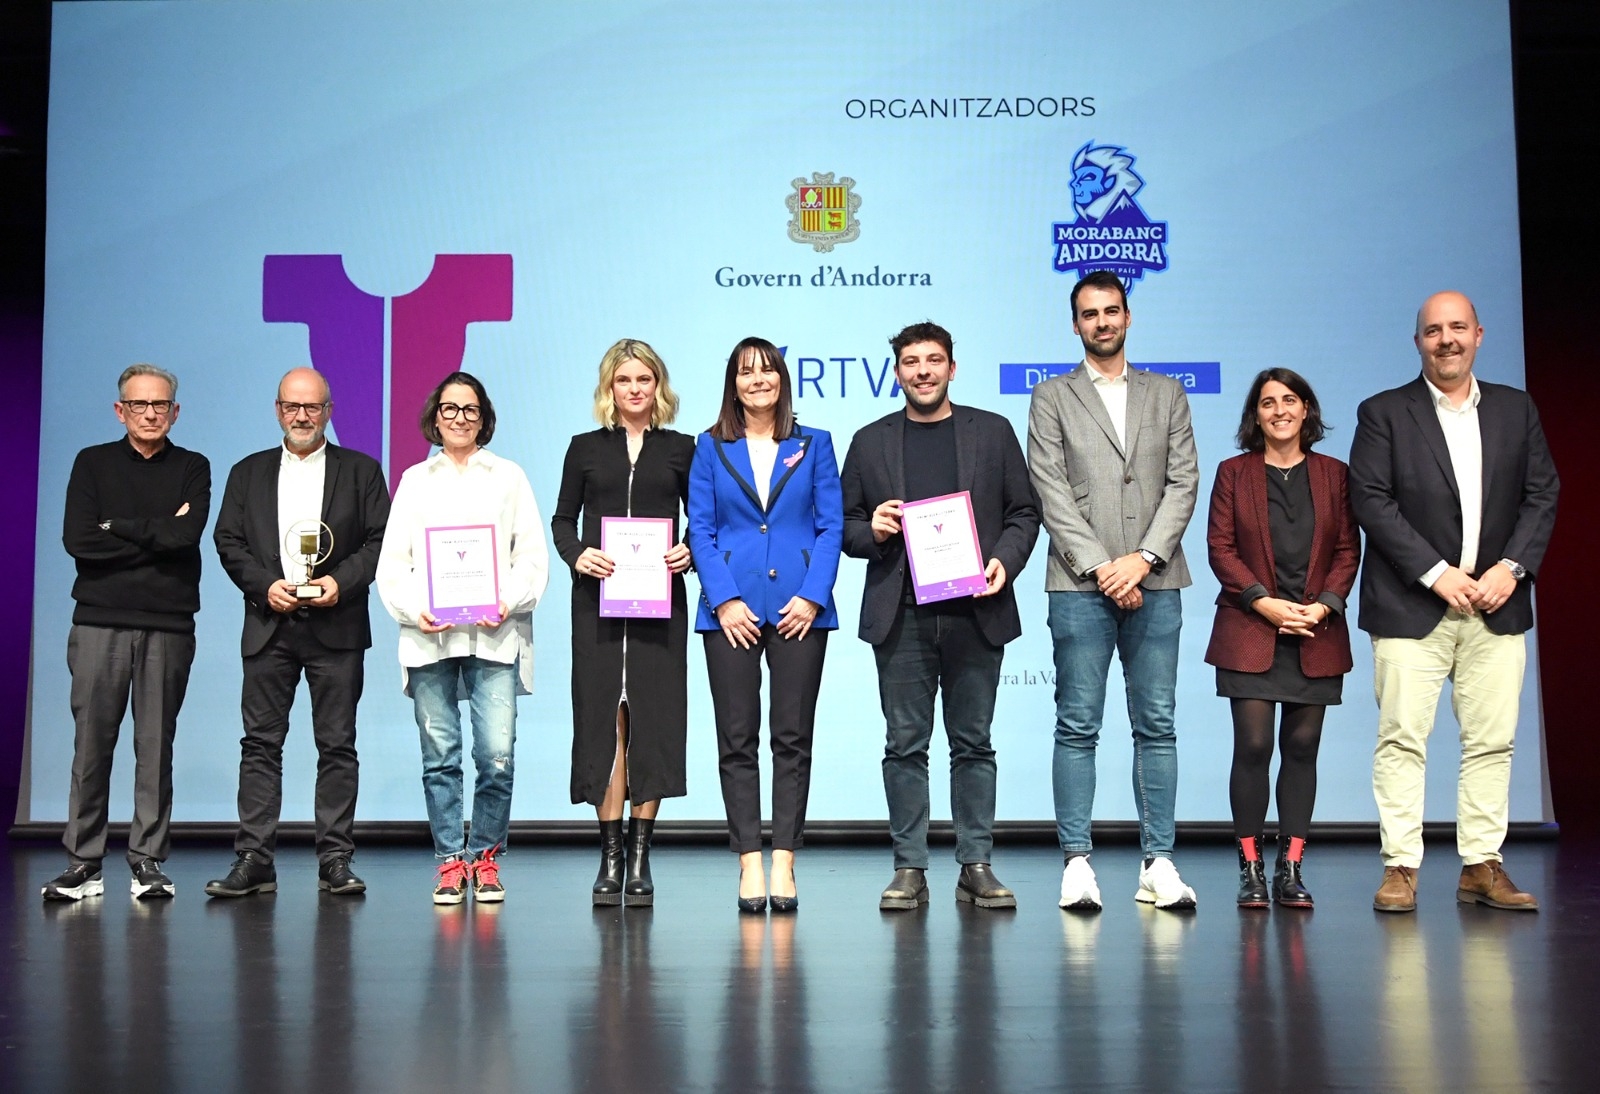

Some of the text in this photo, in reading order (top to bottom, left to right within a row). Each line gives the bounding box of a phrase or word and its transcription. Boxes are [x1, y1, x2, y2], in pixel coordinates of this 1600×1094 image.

[845, 97, 1096, 119] ORGANITZADORS
[1058, 226, 1162, 240] MORABANC
[1058, 242, 1163, 265] ANDORRA
[715, 265, 933, 287] Govern d'Andorra
[798, 357, 903, 398] RTV
[1024, 669, 1037, 685] la
